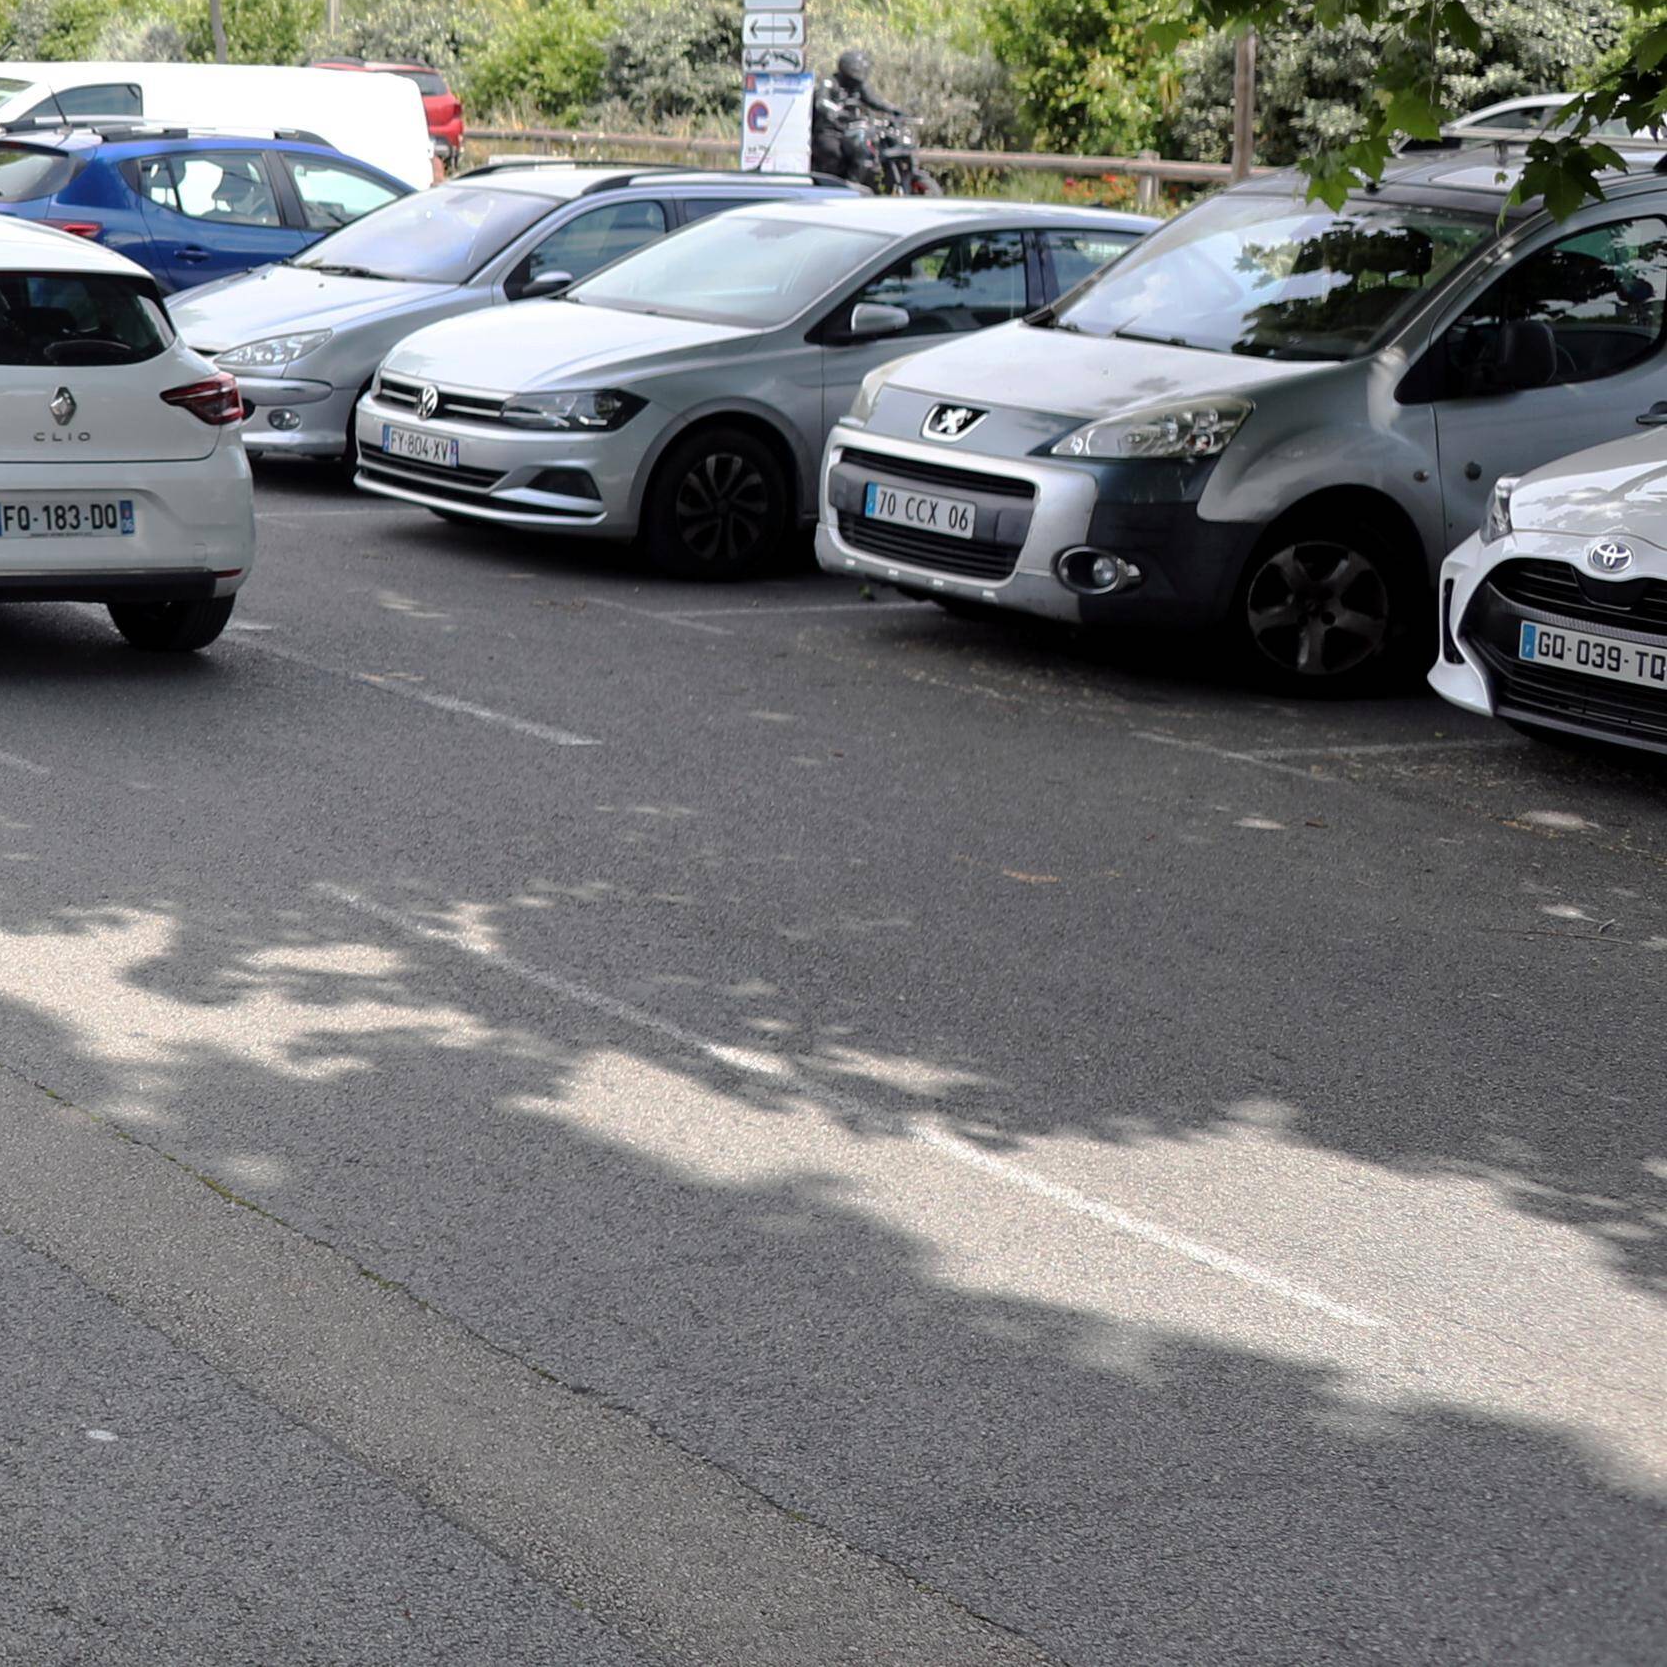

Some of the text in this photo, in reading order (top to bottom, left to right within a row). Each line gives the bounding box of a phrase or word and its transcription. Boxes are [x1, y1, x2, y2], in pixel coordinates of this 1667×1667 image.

[33, 432, 91, 442] CLIO
[390, 429, 449, 462] FY-804-XV
[3, 503, 118, 531] FQ-183-DQ
[879, 490, 969, 531] 70 CCX 06
[1537, 630, 1667, 682] GQ-039-TQ
